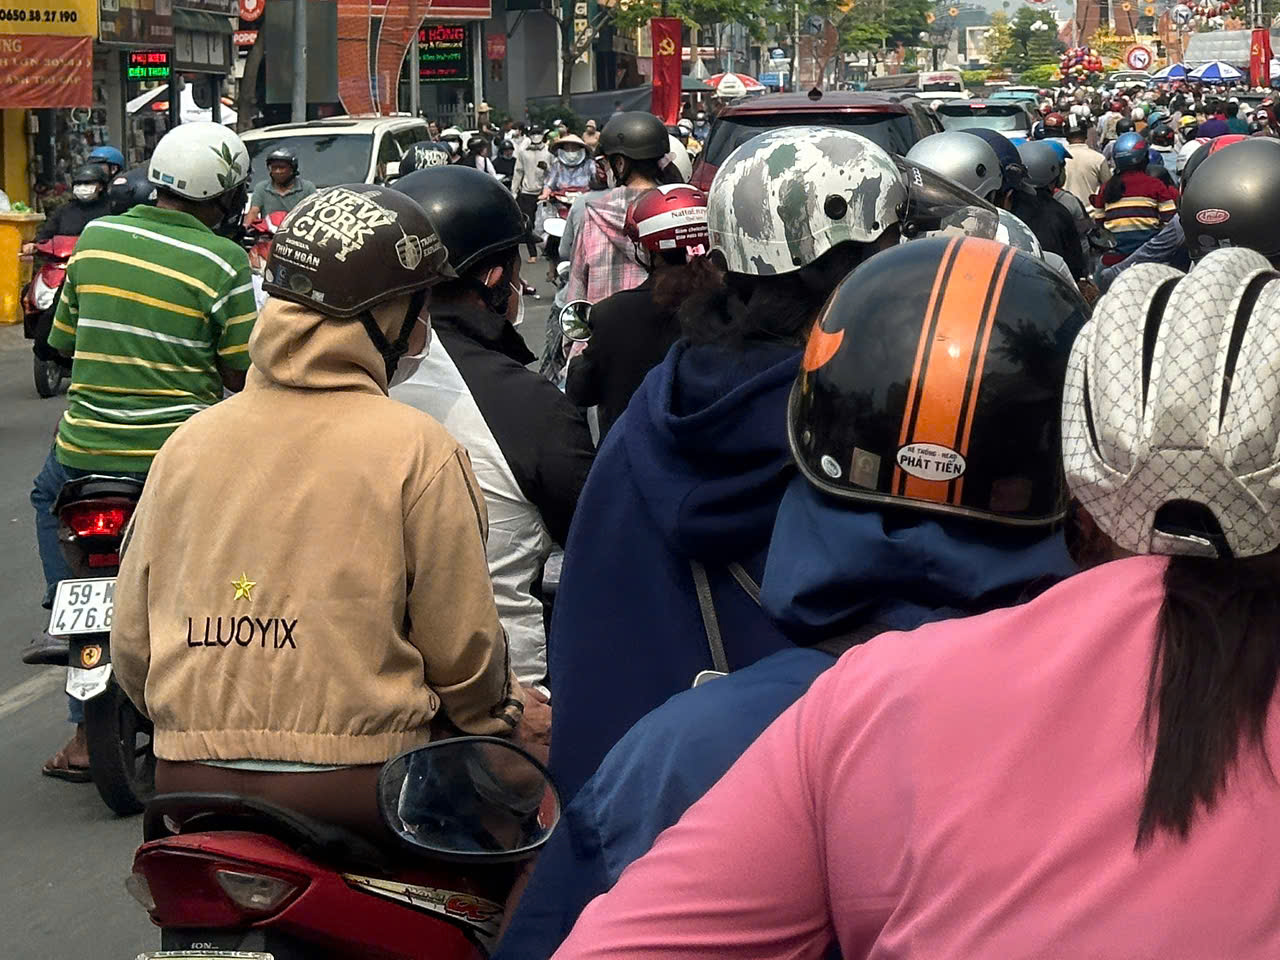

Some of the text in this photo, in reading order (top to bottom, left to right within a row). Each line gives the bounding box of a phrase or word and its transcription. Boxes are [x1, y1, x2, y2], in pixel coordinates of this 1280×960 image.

[306, 200, 375, 246] YORK
[319, 187, 393, 228] NEW
[292, 216, 364, 263] CITY
[187, 615, 298, 649] LLUOYIX
